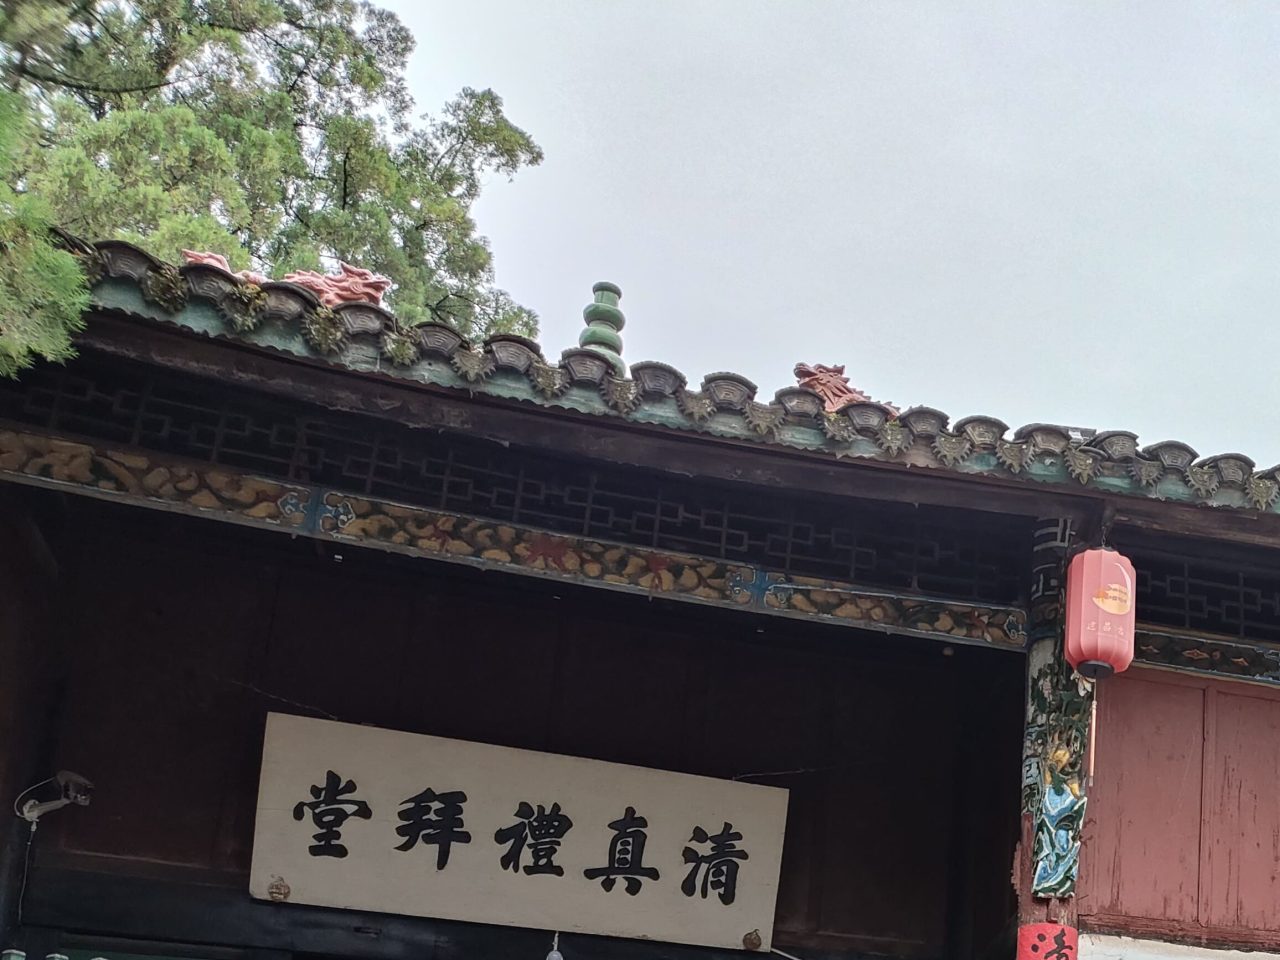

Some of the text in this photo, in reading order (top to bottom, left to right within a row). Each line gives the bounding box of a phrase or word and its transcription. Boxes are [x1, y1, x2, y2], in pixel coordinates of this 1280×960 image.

[293, 770, 749, 905] 清真禮拜堂
